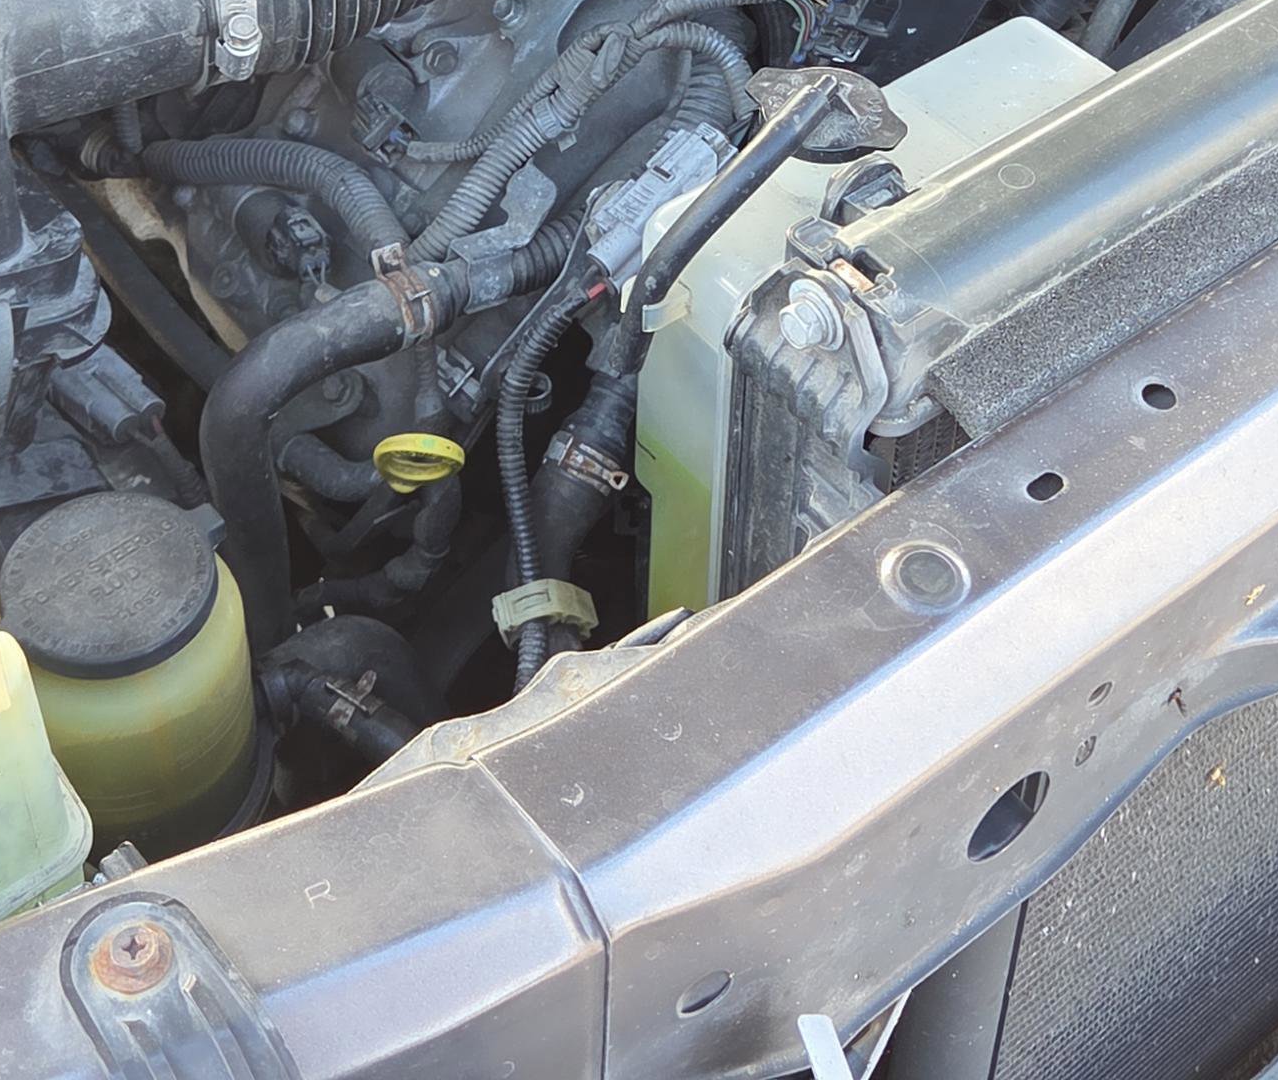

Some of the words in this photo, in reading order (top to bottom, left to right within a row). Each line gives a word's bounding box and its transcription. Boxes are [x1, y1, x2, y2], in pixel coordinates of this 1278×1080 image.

[88, 518, 178, 575] STEERING
[88, 565, 141, 603] FLUID
[304, 879, 337, 909] R
